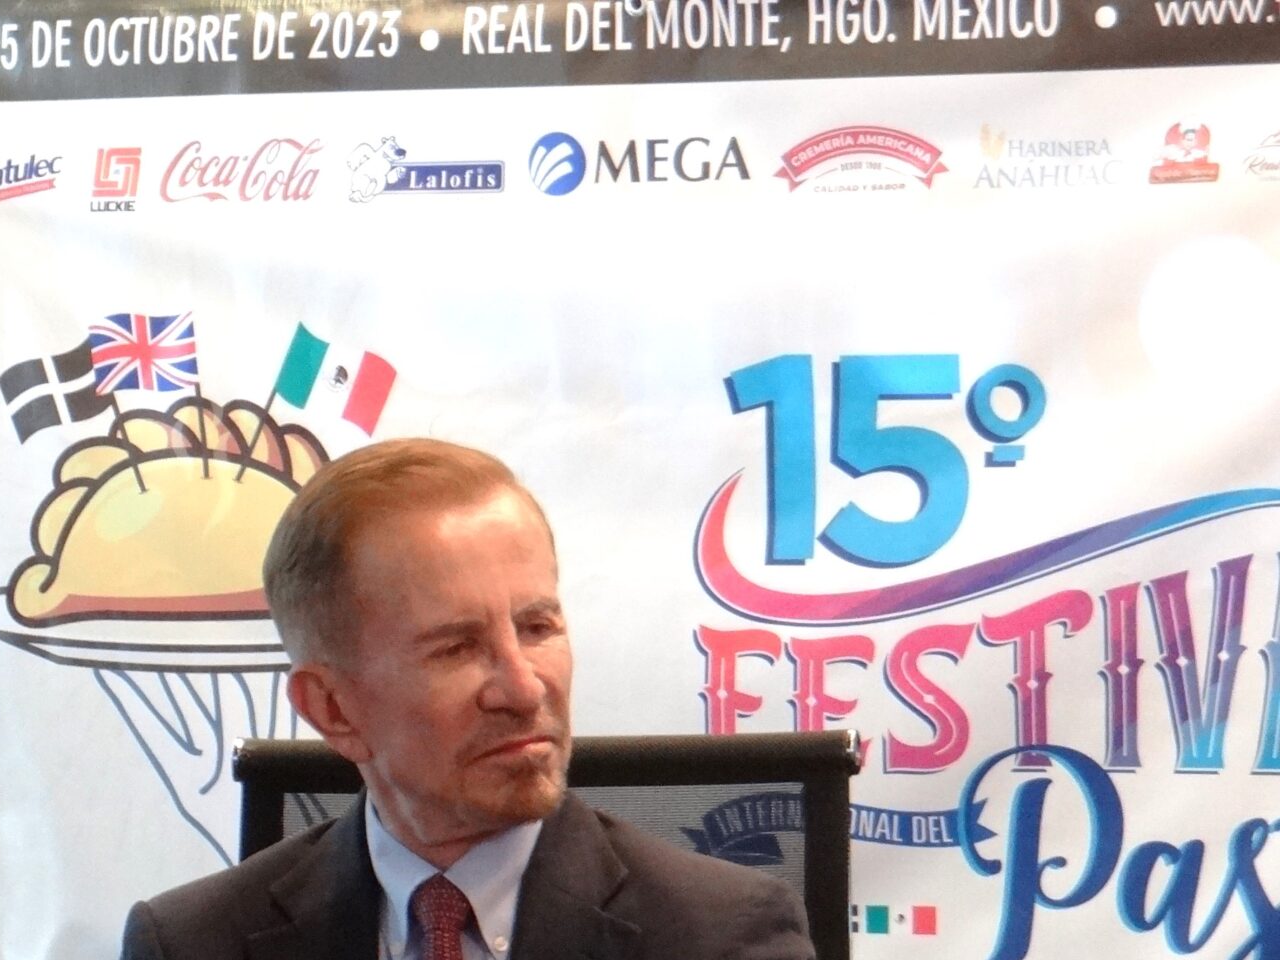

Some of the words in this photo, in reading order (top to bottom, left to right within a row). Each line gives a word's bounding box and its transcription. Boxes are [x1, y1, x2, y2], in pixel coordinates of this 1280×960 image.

[31, 19, 73, 68] DE
[83, 13, 241, 68] OCTUBRE
[252, 10, 298, 60] DE
[307, 9, 402, 59] 2023
[462, 4, 552, 55] REAL
[564, 0, 632, 51] DEL
[646, 0, 792, 52] MONTE,
[807, 0, 896, 45] HGO.
[593, 136, 751, 184] MEGA
[790, 134, 855, 167] CREMERÍA
[856, 134, 933, 165] AMERICANA
[408, 167, 498, 190] Lalofis
[693, 553, 1280, 776] FESTIV
[912, 814, 954, 844] DEL
